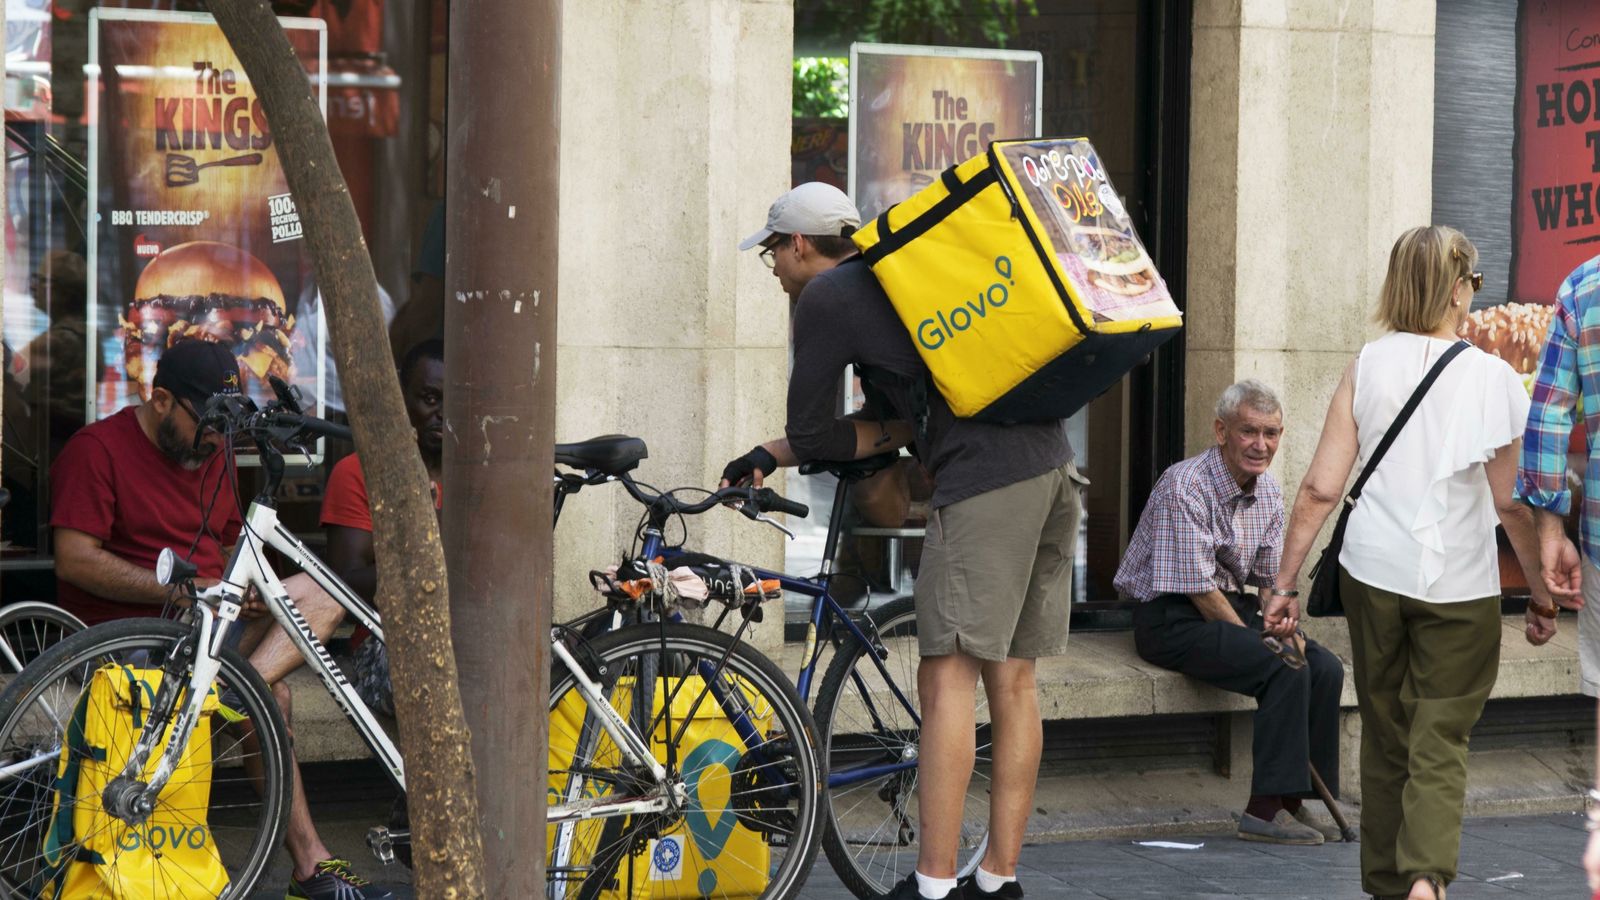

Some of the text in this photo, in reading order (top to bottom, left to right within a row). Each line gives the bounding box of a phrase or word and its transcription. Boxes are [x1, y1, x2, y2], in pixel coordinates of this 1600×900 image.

[193, 61, 236, 95] The
[932, 89, 968, 120] The
[154, 97, 273, 151] KINGS
[111, 210, 133, 226] BBQ
[271, 221, 303, 240] POLLO
[136, 244, 160, 255] NUEVO
